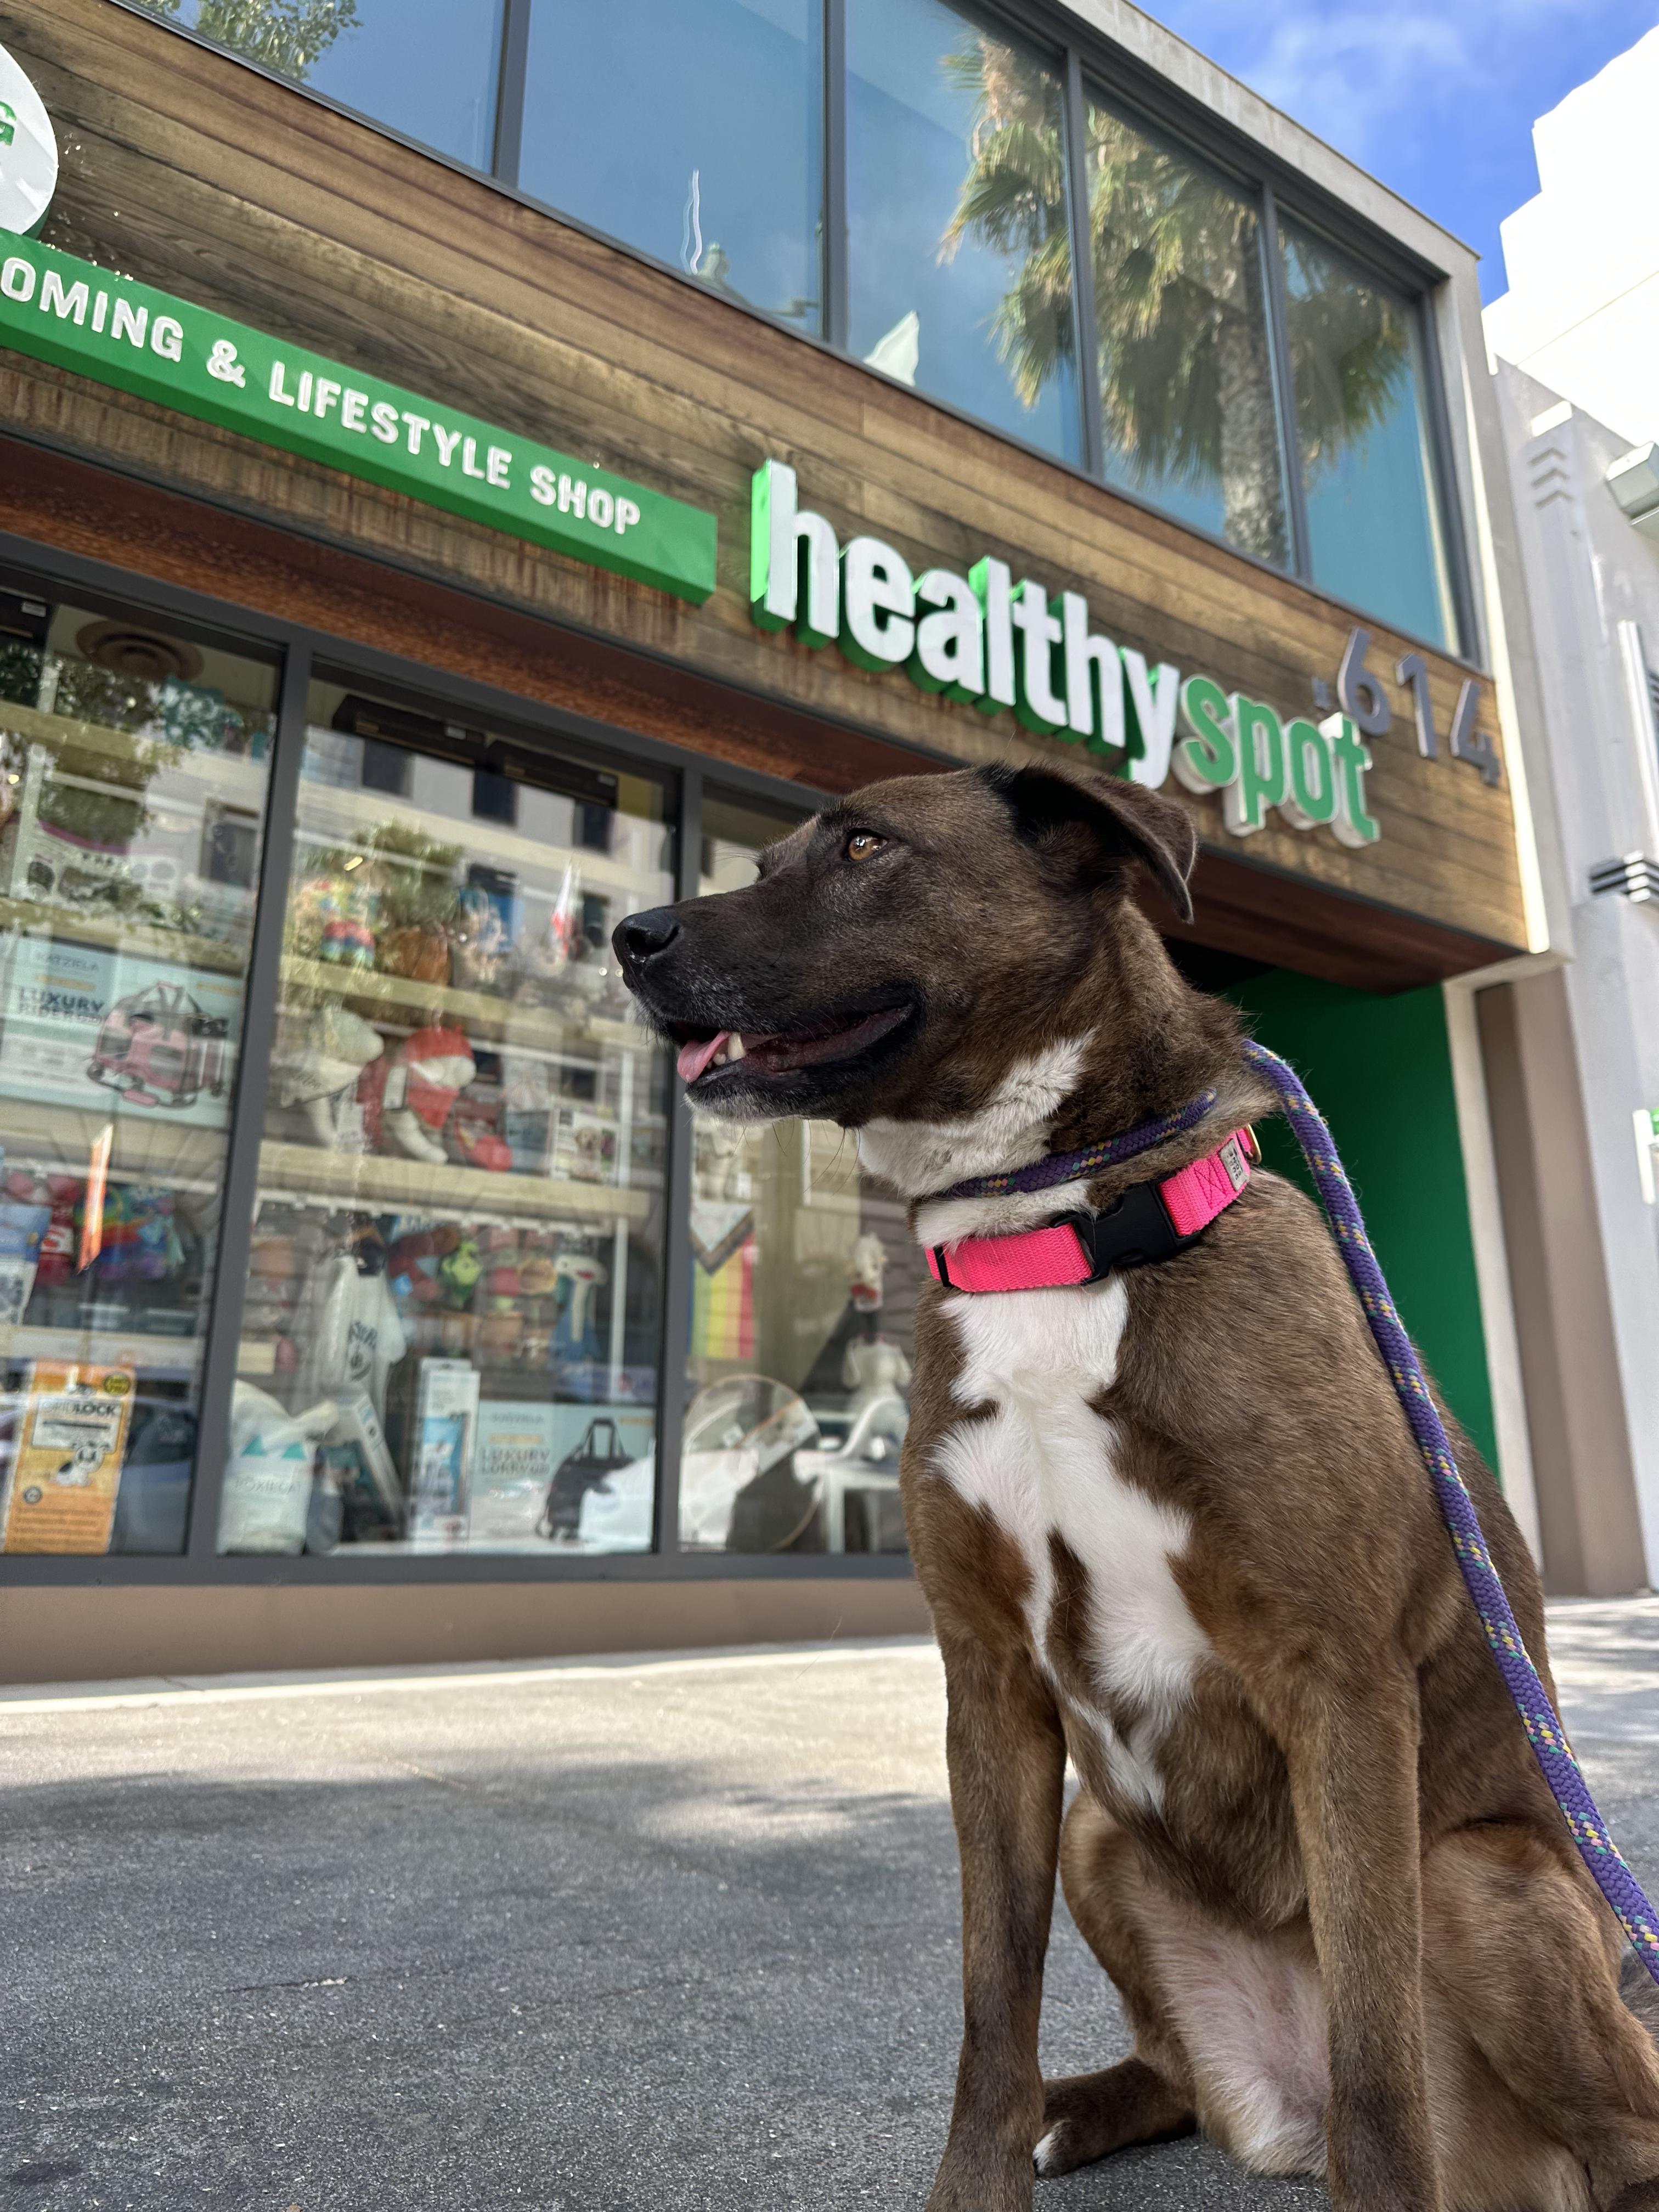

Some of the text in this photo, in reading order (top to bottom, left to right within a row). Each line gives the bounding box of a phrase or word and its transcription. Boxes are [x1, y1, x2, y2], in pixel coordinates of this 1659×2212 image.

[1, 257, 641, 535] OMING & LIFESTYLE SHOP
[1338, 627, 1500, 787] 614
